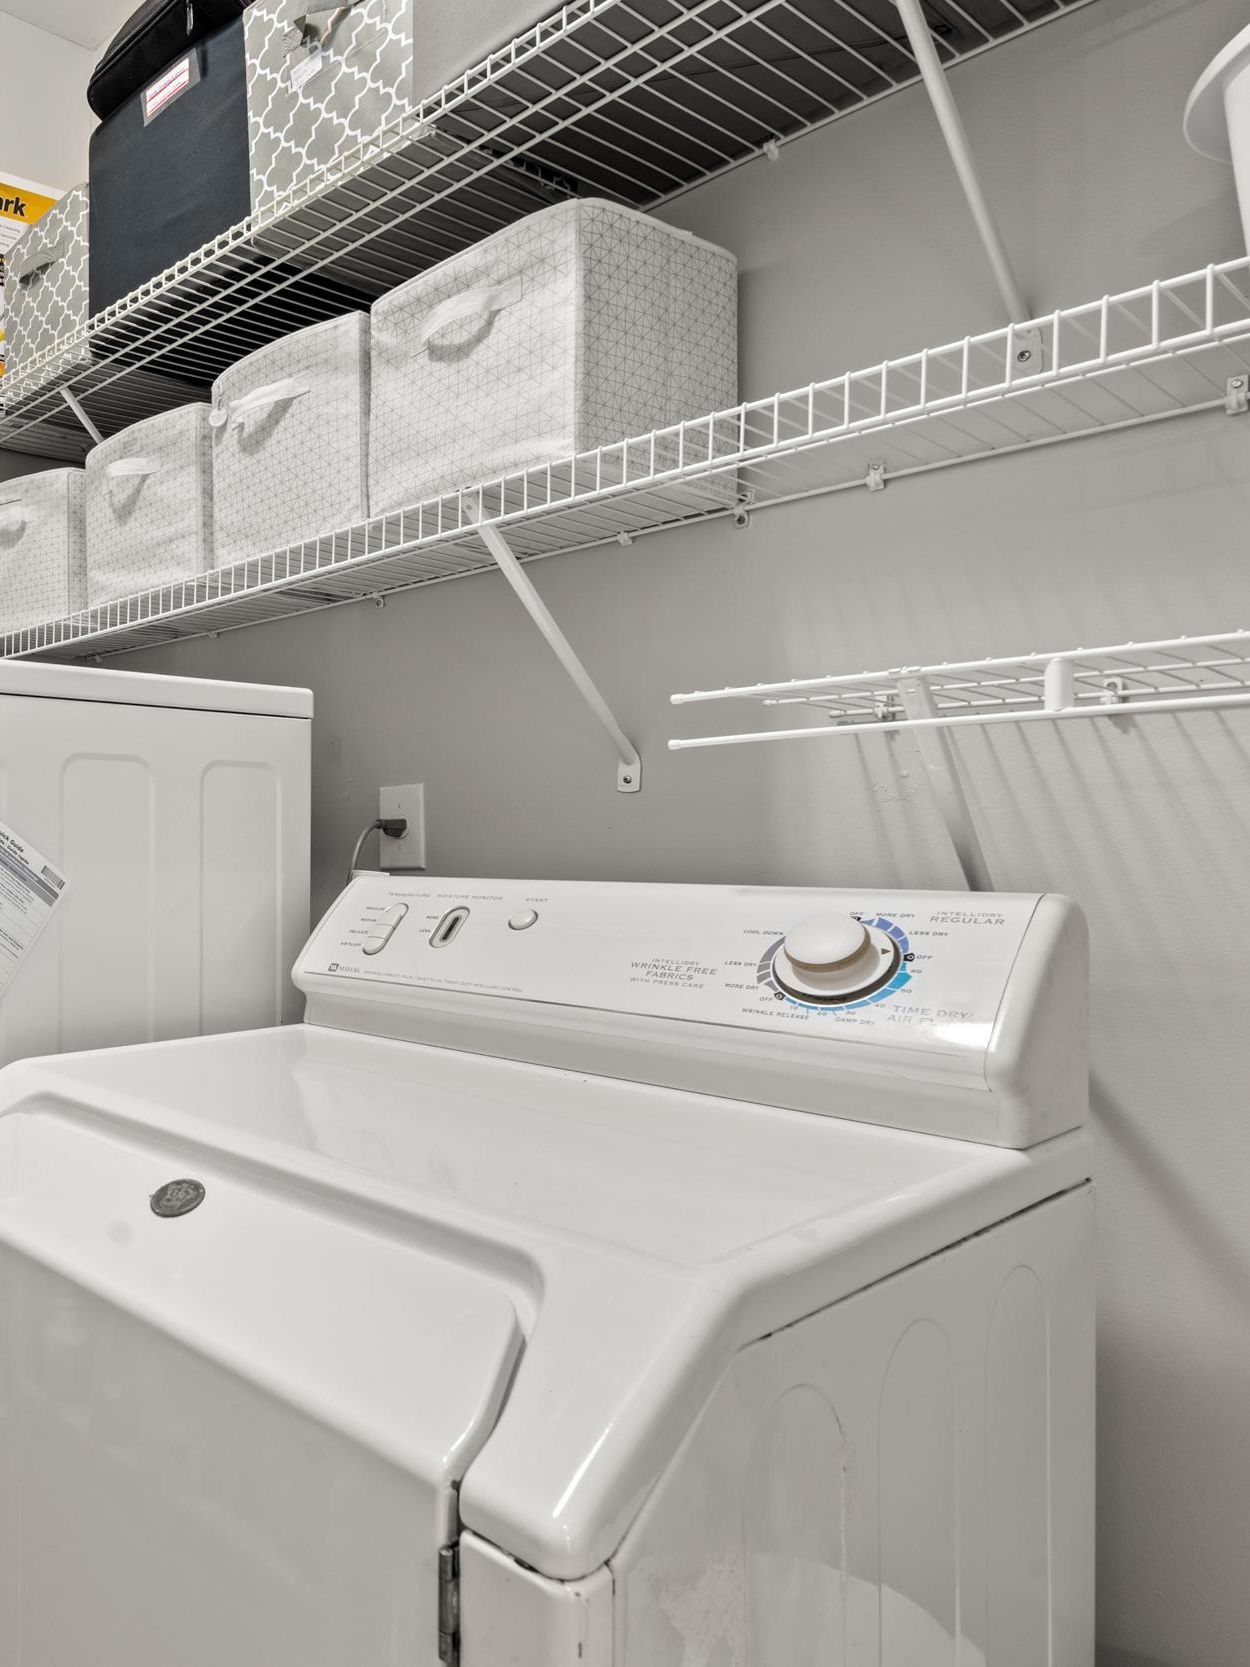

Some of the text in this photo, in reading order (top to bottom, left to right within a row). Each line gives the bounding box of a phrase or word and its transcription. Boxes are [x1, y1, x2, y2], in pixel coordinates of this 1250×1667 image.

[10, 839, 24, 853] Guide
[929, 916, 1006, 926] REGULAR
[652, 957, 701, 966] INTELLIDRY
[630, 961, 718, 976] WRINKLE FREE
[645, 970, 694, 981] FABRICS
[725, 982, 744, 990] MORE
[742, 1007, 811, 1021] WRINKLE RELEASE
[893, 1004, 932, 1016] TIME
[834, 1015, 858, 1023] DAMP
[886, 1014, 911, 1024] AIR
